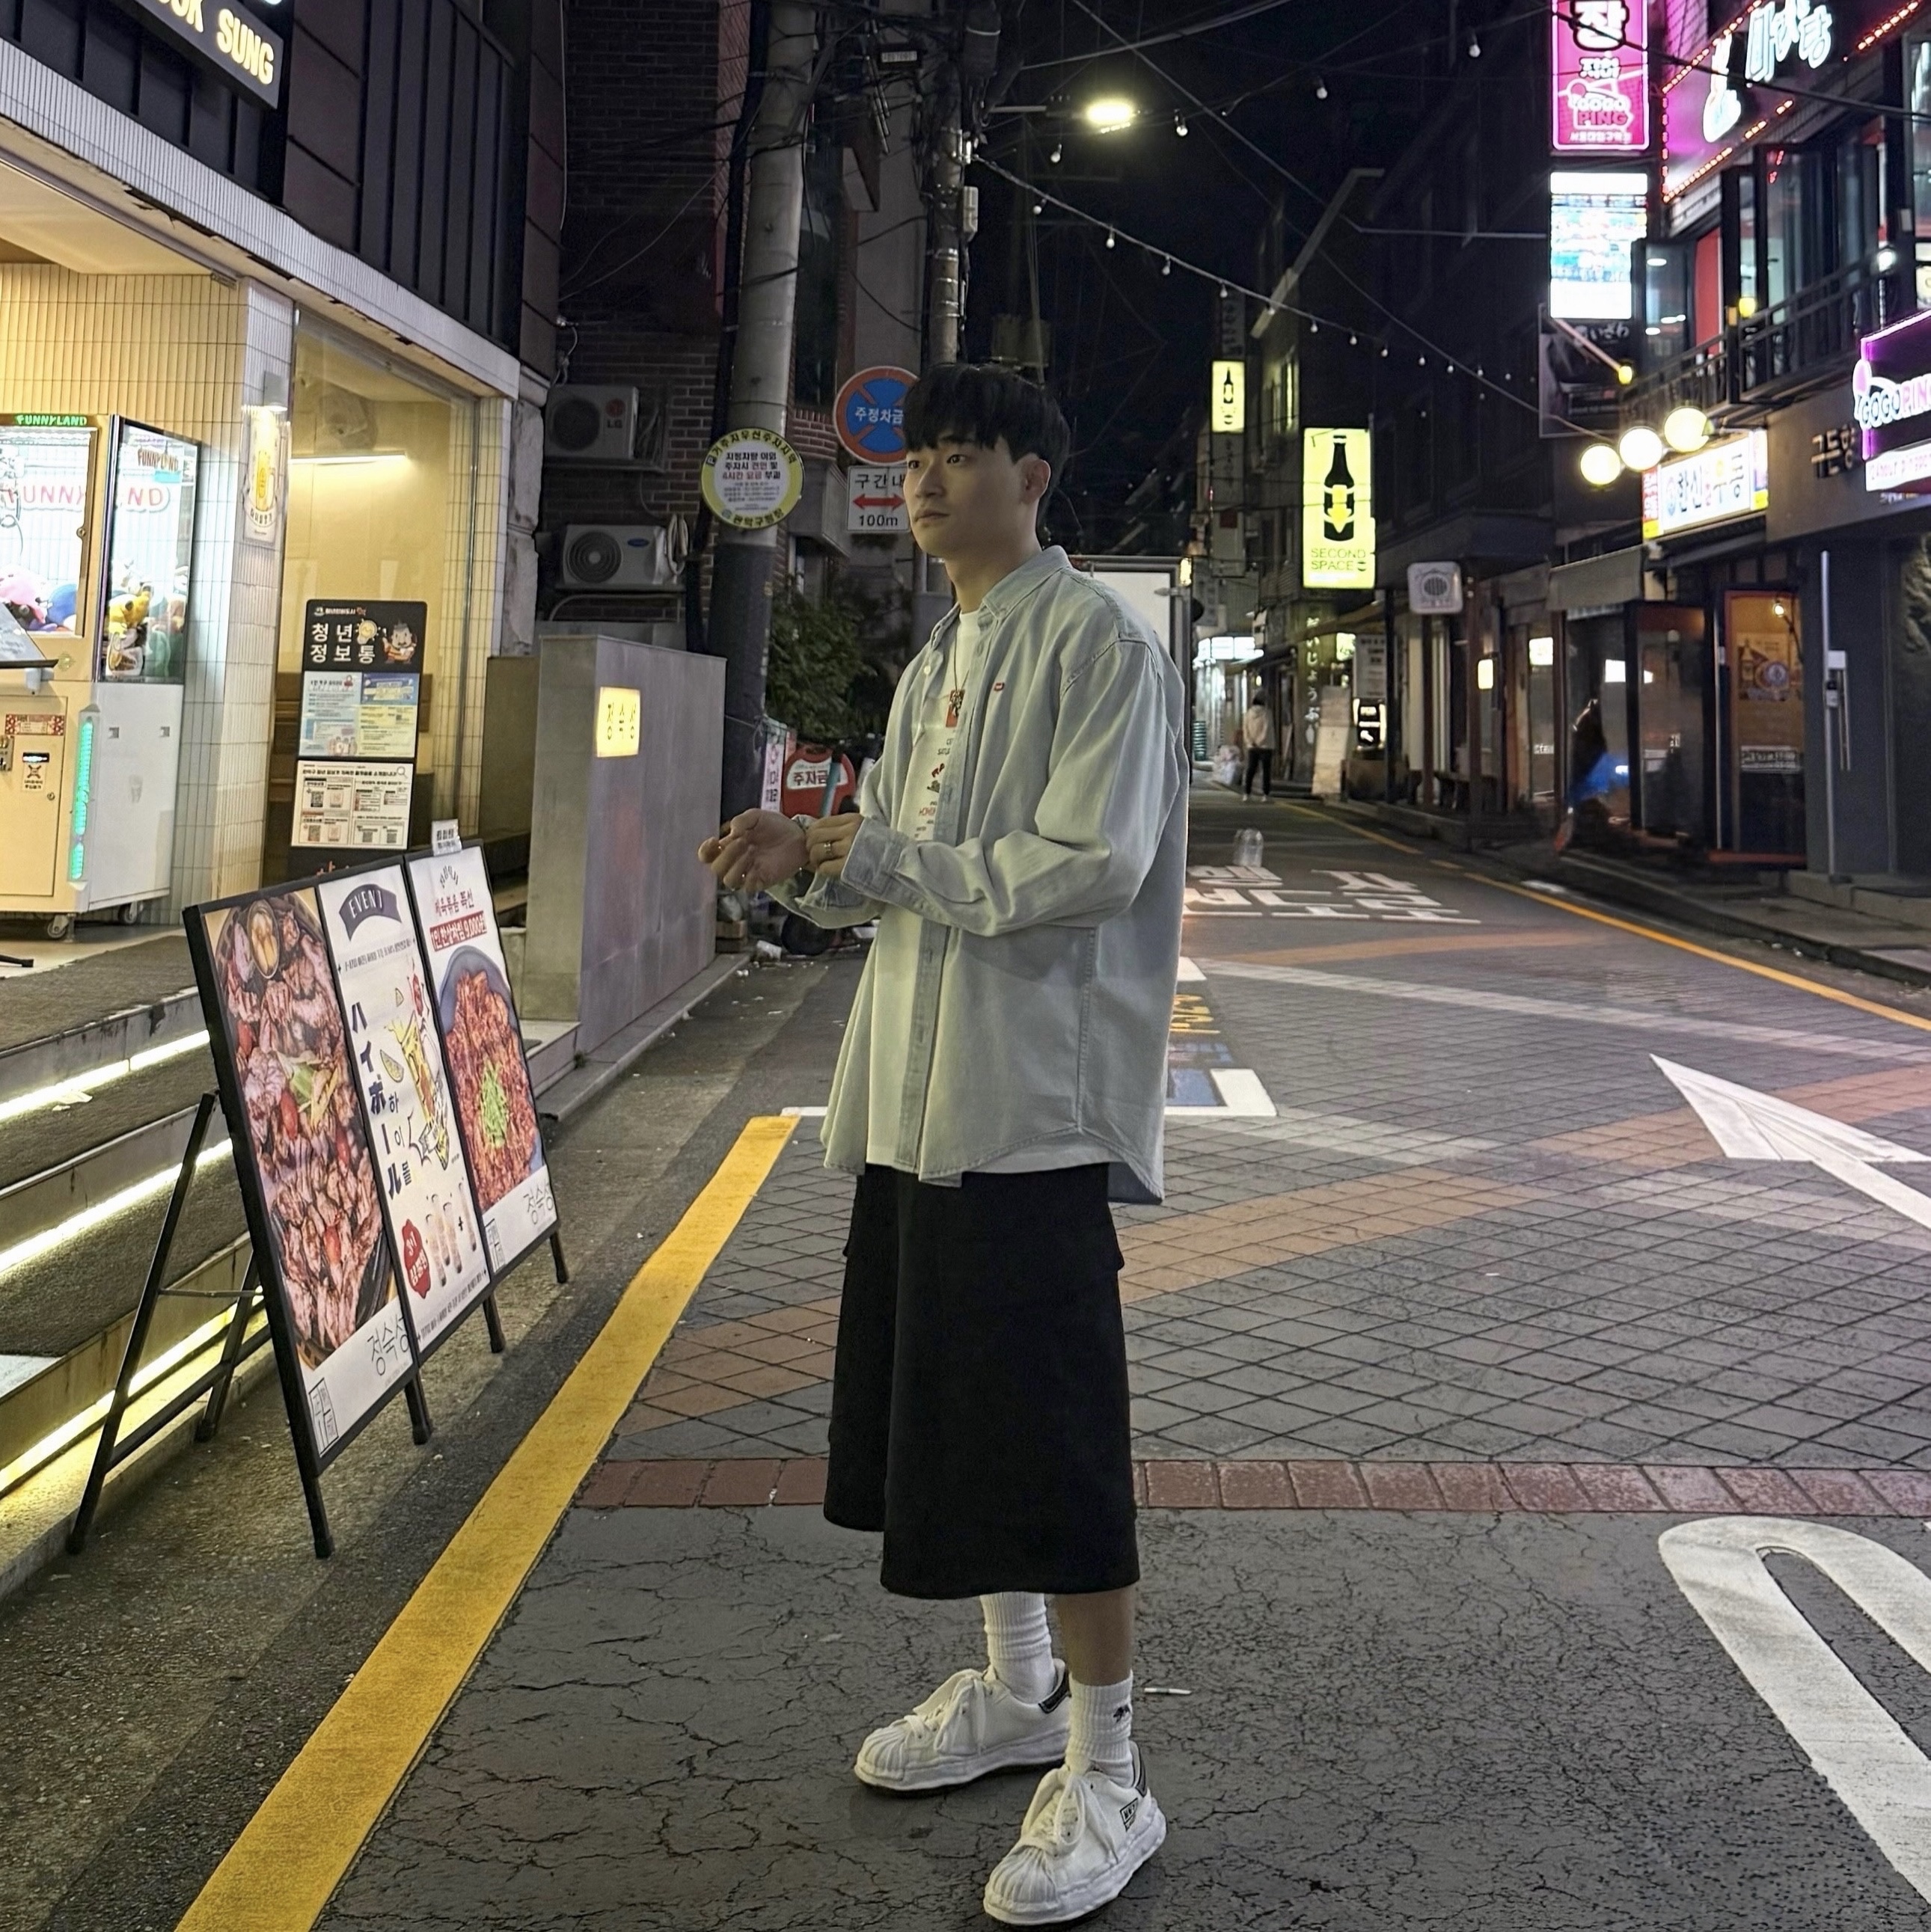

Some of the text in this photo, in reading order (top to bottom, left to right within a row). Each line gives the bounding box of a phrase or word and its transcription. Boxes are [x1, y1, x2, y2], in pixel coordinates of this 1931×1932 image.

[217, 8, 275, 85] SUNG
[1578, 111, 1628, 126] PING
[1861, 375, 1931, 426] GOGOPIN
[16, 414, 88, 426] FUNNYLAND
[607, 419, 623, 429] LG
[855, 407, 905, 425] 주정차금
[859, 514, 899, 527] 100m
[1311, 548, 1366, 559] SECOND
[1311, 560, 1354, 571] SPACE
[311, 622, 352, 643] 청년
[310, 644, 376, 664] 정보통
[793, 770, 828, 786] 주차금
[349, 889, 383, 919] EVENT
[1183, 888, 1483, 924] 선도로
[352, 1002, 402, 1200] ハイボール
[523, 1179, 554, 1225] 정숙성
[367, 1313, 410, 1376] 정숙성
